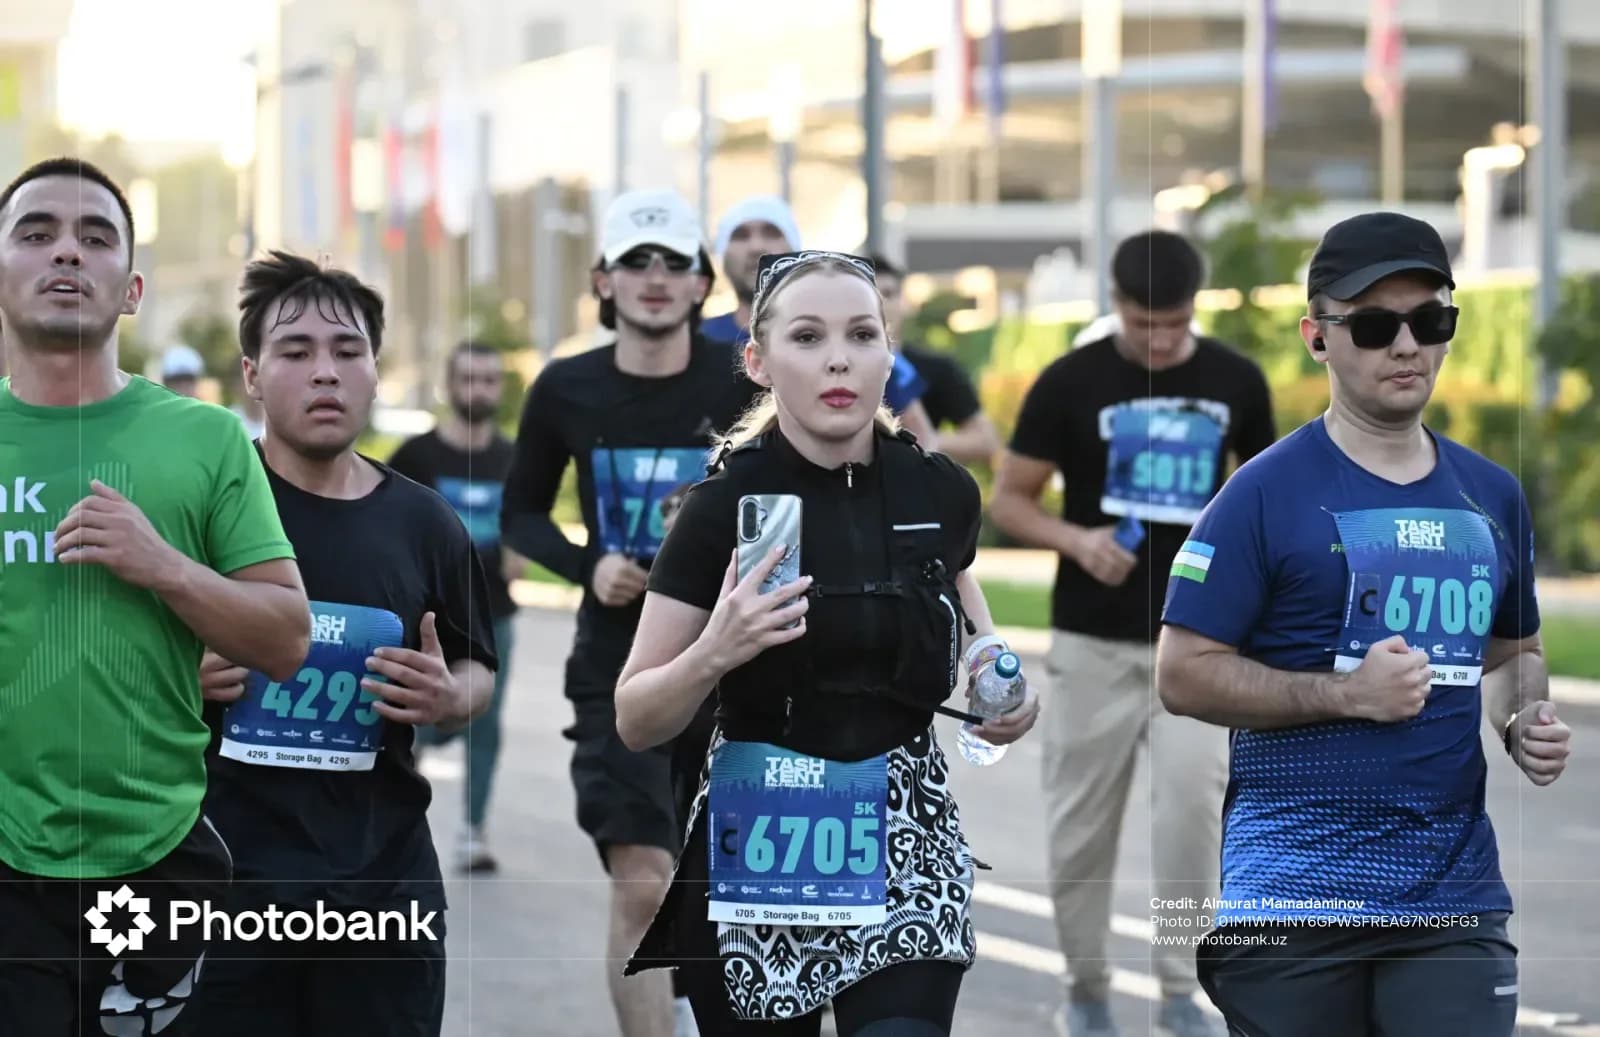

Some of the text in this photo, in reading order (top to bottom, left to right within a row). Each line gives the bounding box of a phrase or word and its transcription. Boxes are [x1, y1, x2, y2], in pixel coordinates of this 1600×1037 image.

[1395, 519, 1444, 538] TASH
[1397, 531, 1444, 546] KENT
[1471, 565, 1490, 578] 5K
[1359, 589, 1377, 616] C
[1384, 576, 1493, 636] 6708
[261, 667, 387, 726] 4295
[246, 749, 350, 765] 4295 Storage Bag 4295
[765, 756, 825, 775] TASH
[765, 769, 824, 785] KENT
[854, 802, 876, 815] 5K
[721, 829, 737, 856] C
[744, 816, 879, 875] 6705
[763, 910, 799, 921] Storage
[801, 911, 820, 922] Bag
[828, 911, 852, 920] 6705
